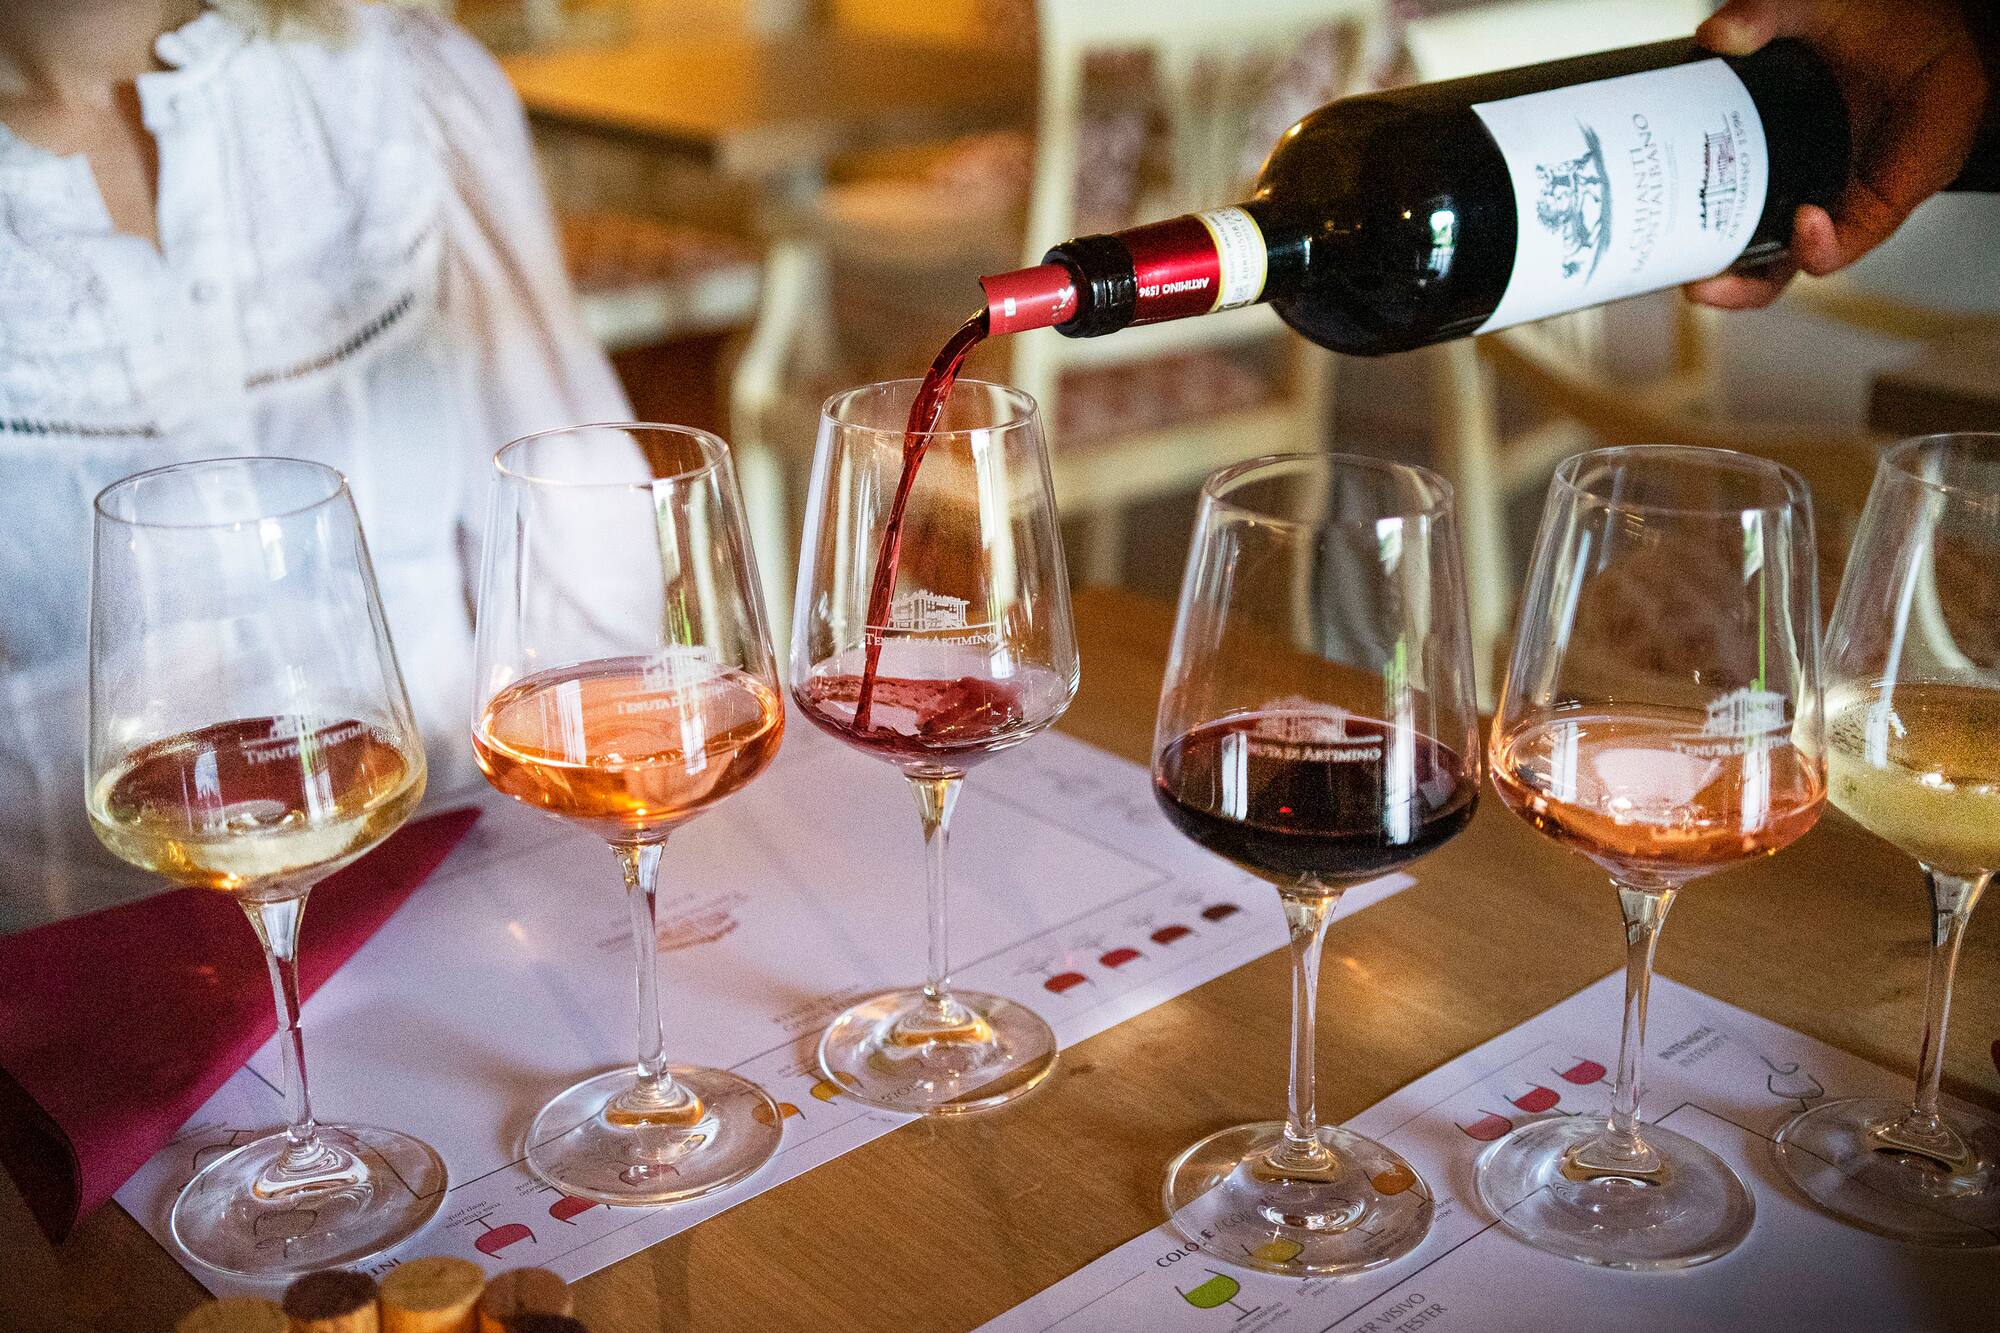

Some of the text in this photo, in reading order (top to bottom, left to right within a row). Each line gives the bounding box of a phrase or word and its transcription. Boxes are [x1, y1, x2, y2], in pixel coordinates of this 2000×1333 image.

[1630, 148, 1650, 249] CHIANTI
[1139, 277, 1210, 298] ARTIMINO 1596
[1156, 1229, 1215, 1268] COLOE
[1376, 1293, 1425, 1323] VISIVO
[1394, 1303, 1447, 1333] TESTER
